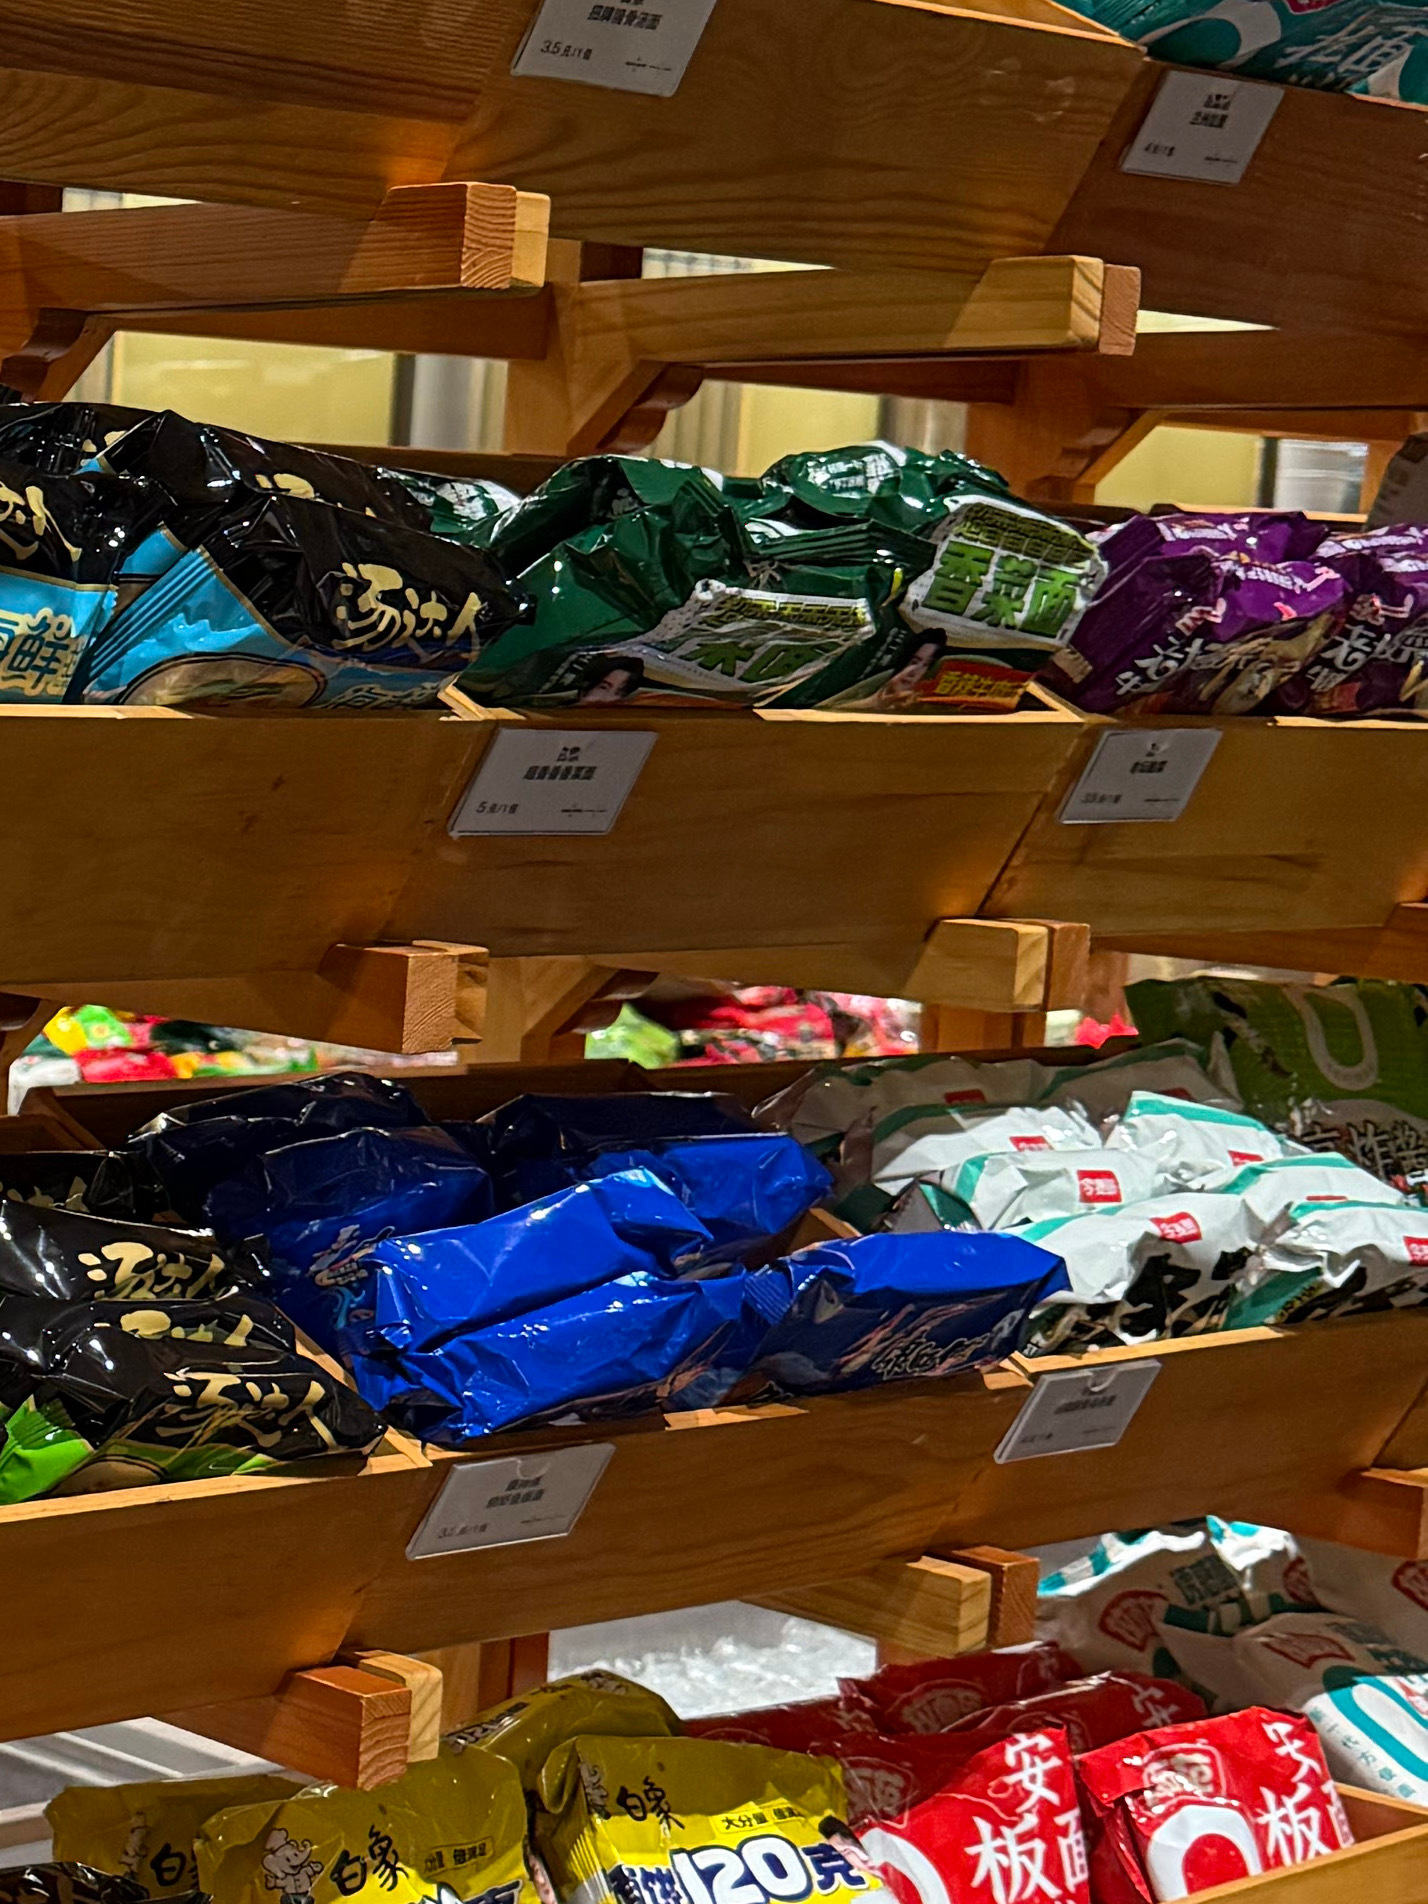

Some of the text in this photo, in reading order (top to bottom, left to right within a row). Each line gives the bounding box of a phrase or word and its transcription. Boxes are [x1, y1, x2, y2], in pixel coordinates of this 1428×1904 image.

[616, 1776, 686, 1830] 白象
[1004, 1733, 1064, 1812] 安
[331, 1823, 409, 1894] 白象
